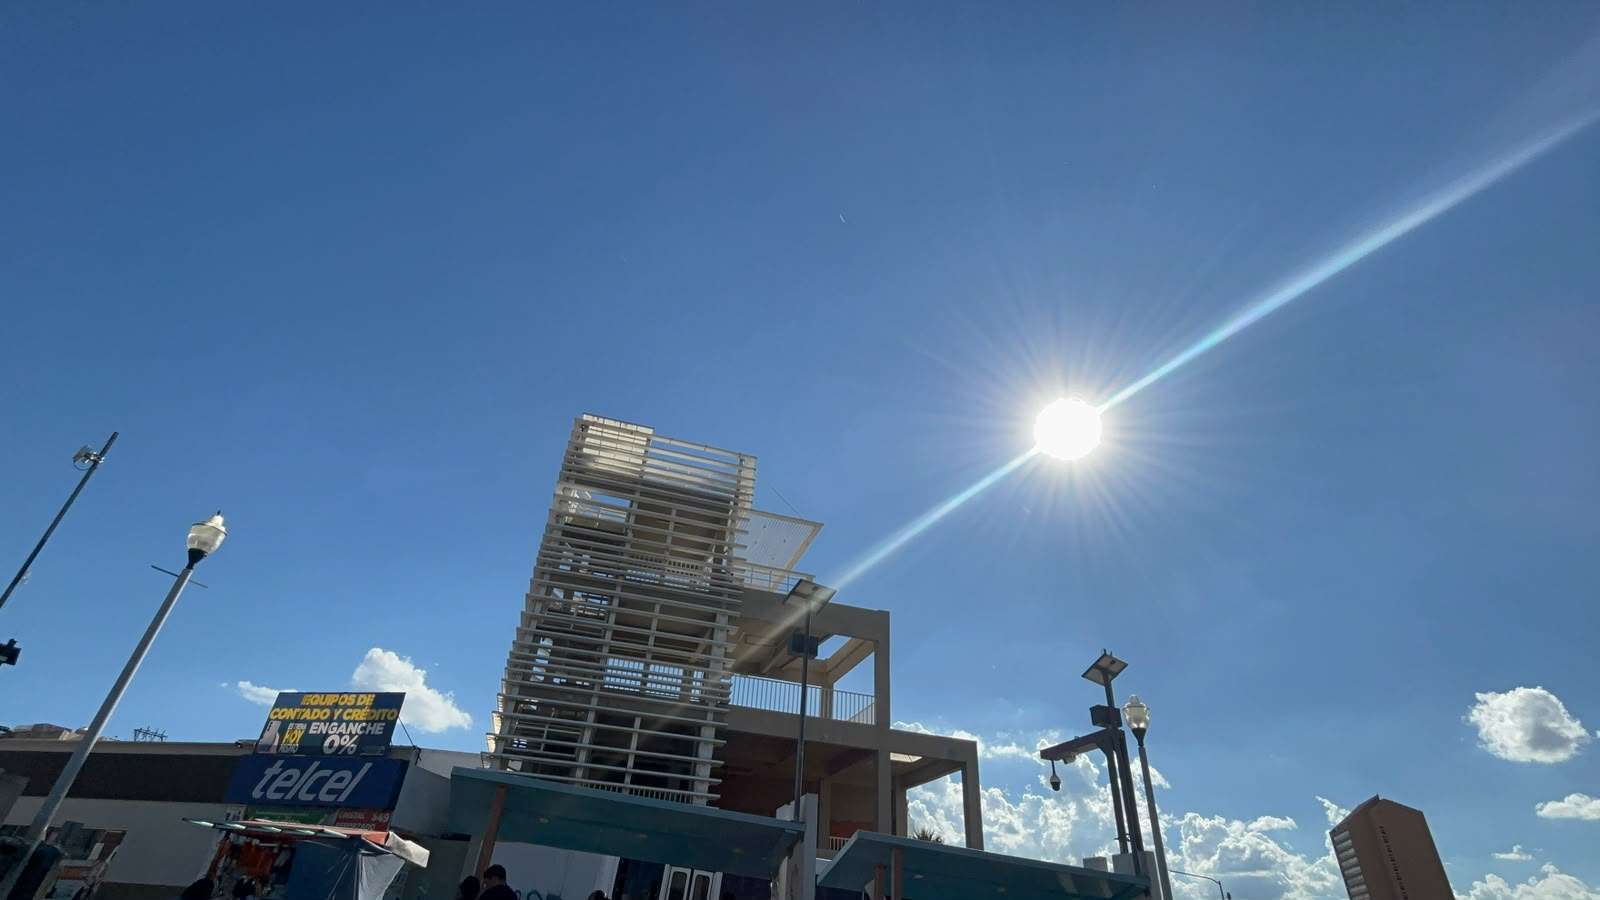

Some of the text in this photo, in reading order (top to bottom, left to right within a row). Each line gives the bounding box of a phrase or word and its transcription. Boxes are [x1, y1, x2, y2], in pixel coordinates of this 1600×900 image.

[301, 693, 376, 705] EQUIPOS DE
[270, 706, 398, 720] CONTADO Y CRÉDITO
[309, 722, 385, 734] ENGANCHE
[283, 729, 305, 744] HOY
[323, 734, 360, 755] 0%
[252, 760, 373, 802] telcel
